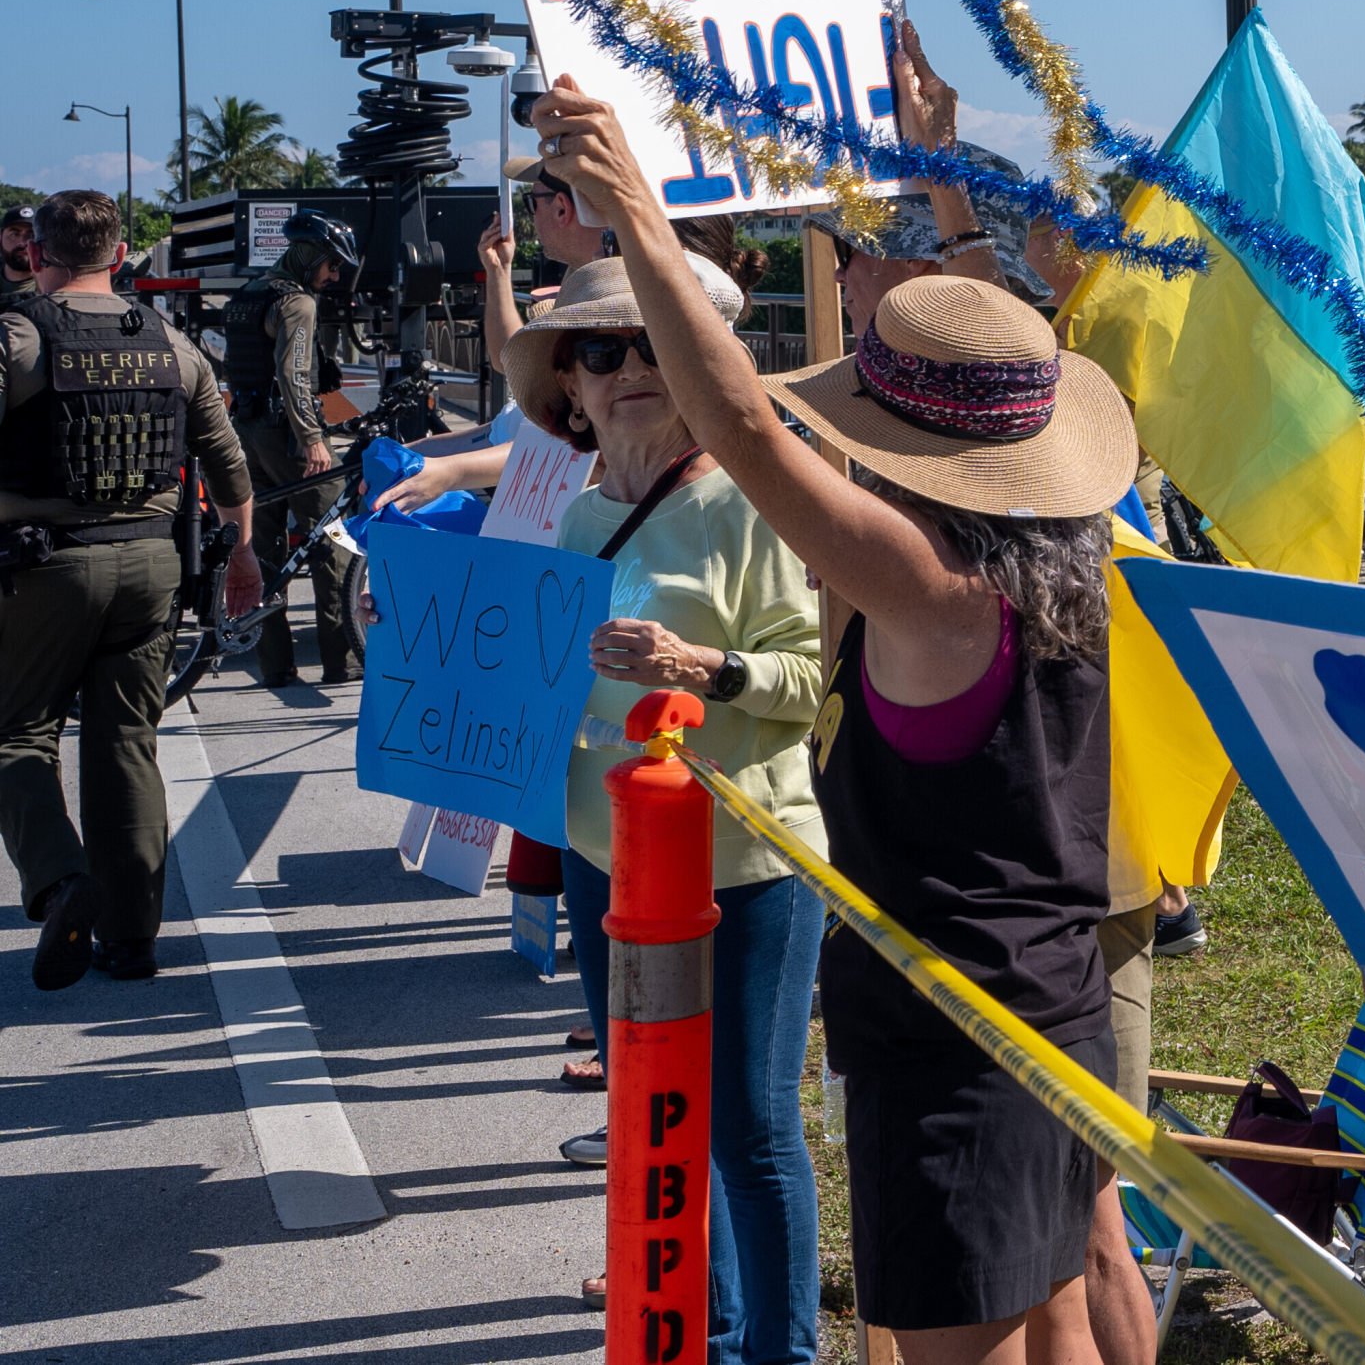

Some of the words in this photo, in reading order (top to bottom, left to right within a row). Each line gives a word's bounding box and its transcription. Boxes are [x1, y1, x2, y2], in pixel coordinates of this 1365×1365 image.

[258, 209, 288, 217] DANGER
[60, 353, 174, 369] SHERIFF
[86, 369, 155, 386] E.F.F.
[498, 446, 580, 532] MAKE
[383, 558, 509, 671] We
[433, 808, 500, 855] AGGRESSOR
[645, 1090, 689, 1364] PBPD
